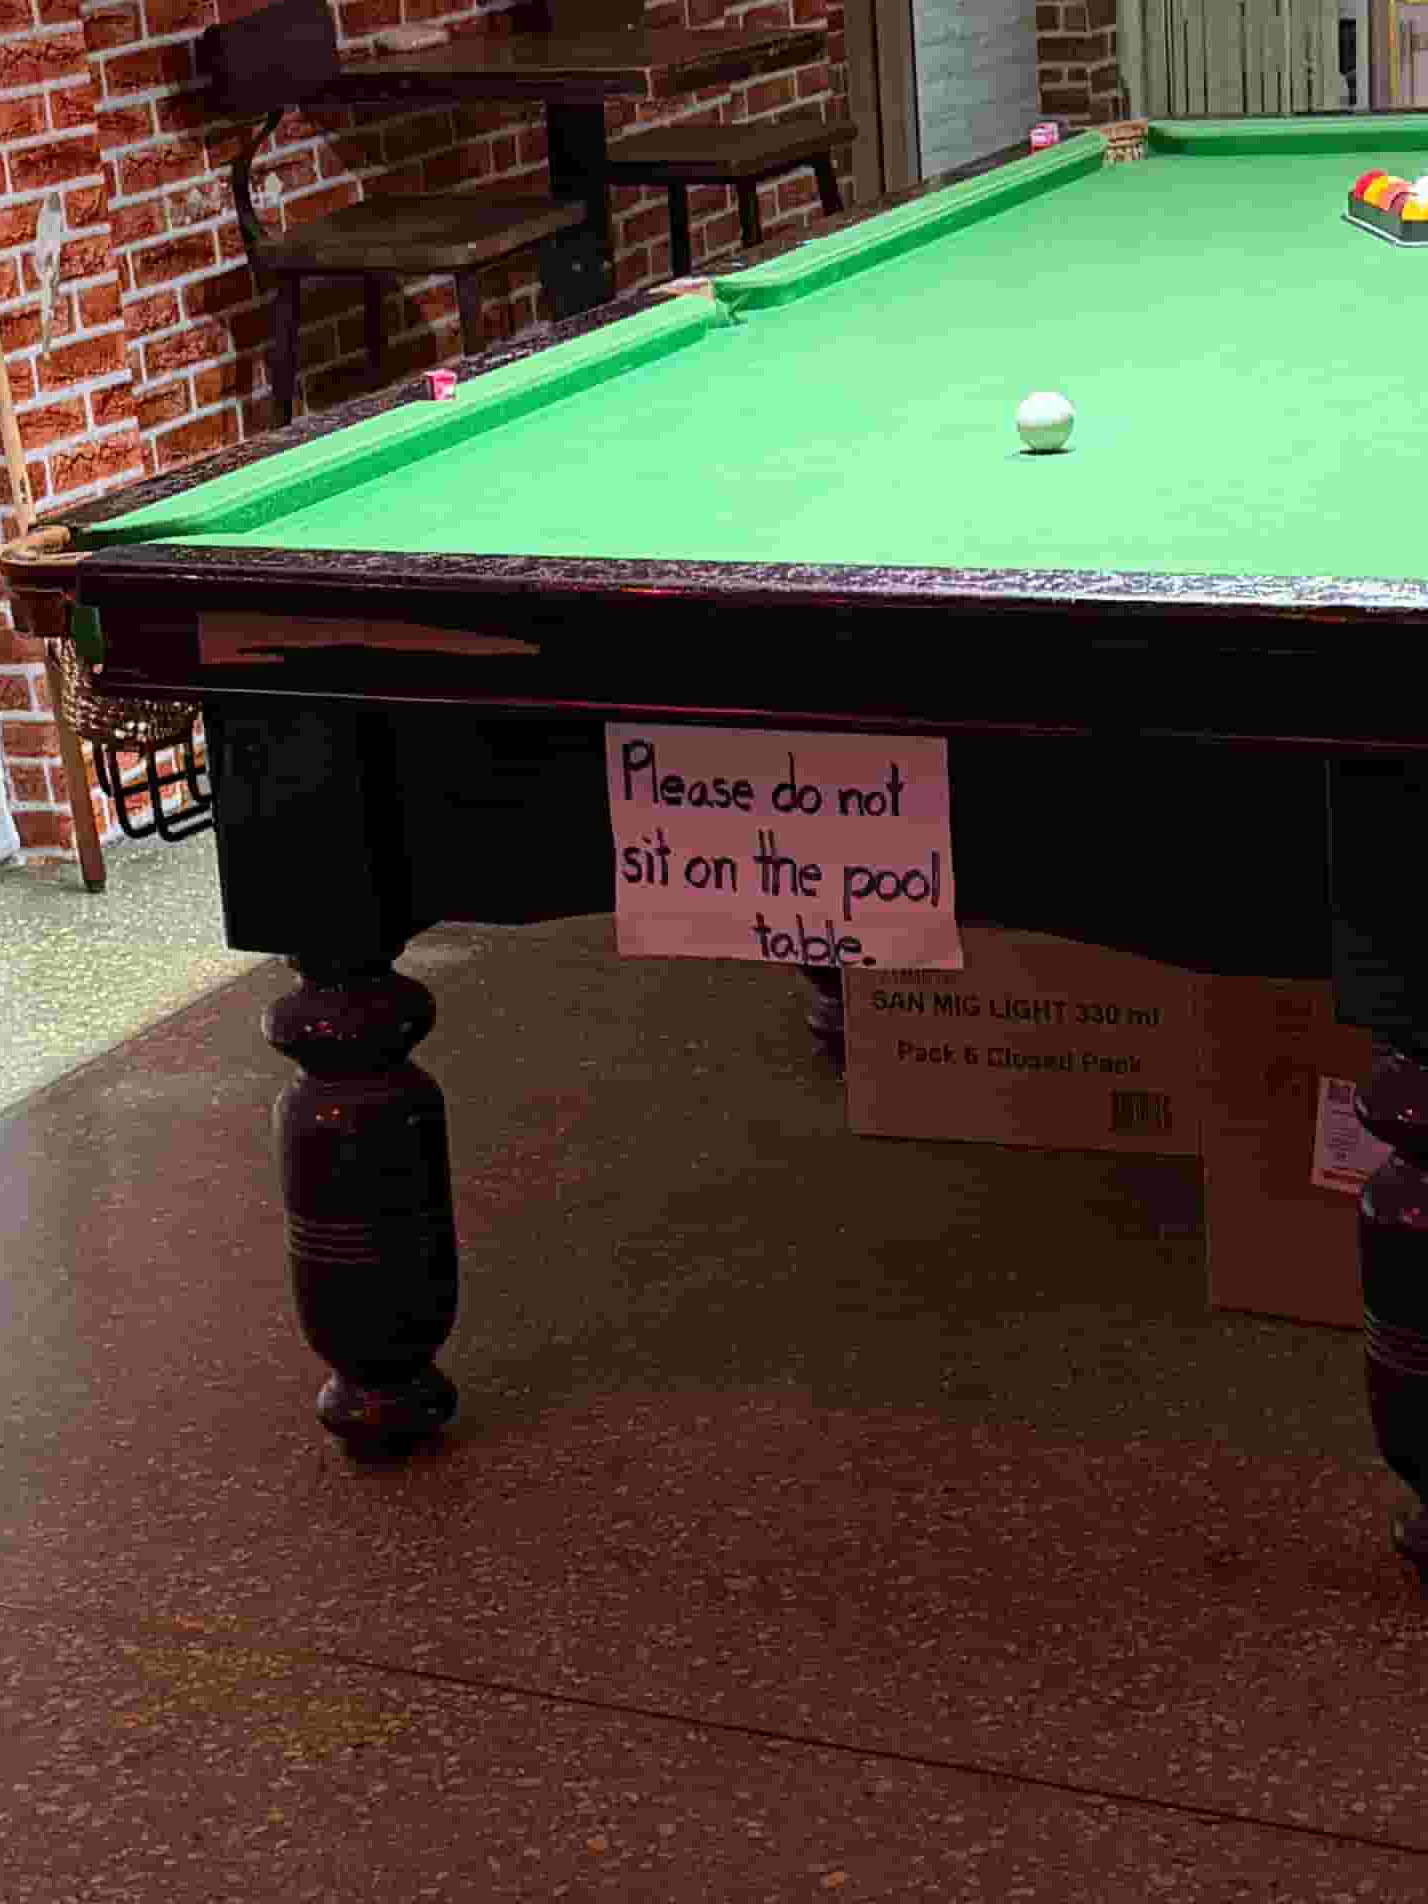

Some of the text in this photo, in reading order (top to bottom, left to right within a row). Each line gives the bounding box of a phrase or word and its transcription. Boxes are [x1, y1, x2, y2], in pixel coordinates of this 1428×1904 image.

[621, 739, 904, 816] Please do not
[621, 826, 941, 922] sit on the pool
[873, 990, 925, 1014] SAN
[932, 992, 981, 1016] MIG
[989, 998, 1069, 1025] LIGHT
[897, 1039, 956, 1065] Pack
